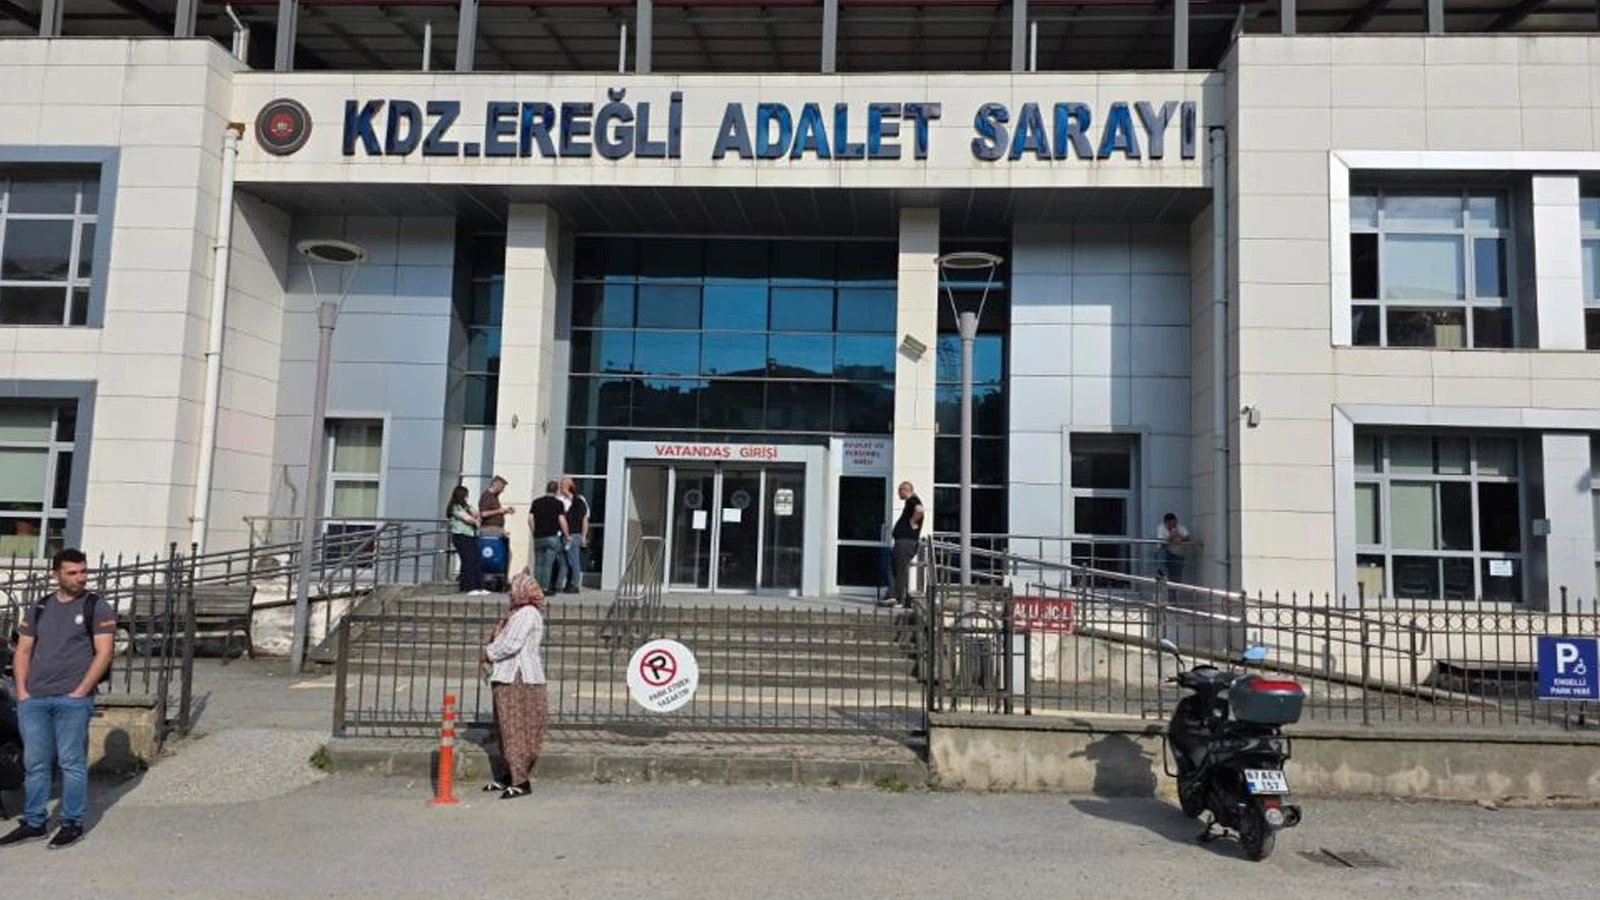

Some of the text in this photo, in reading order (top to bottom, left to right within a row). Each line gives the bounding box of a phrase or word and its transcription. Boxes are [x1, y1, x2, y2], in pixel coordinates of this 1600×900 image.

[712, 101, 941, 160] ADALET
[971, 101, 1196, 160] SARAYI
[1556, 643, 1579, 674] P
